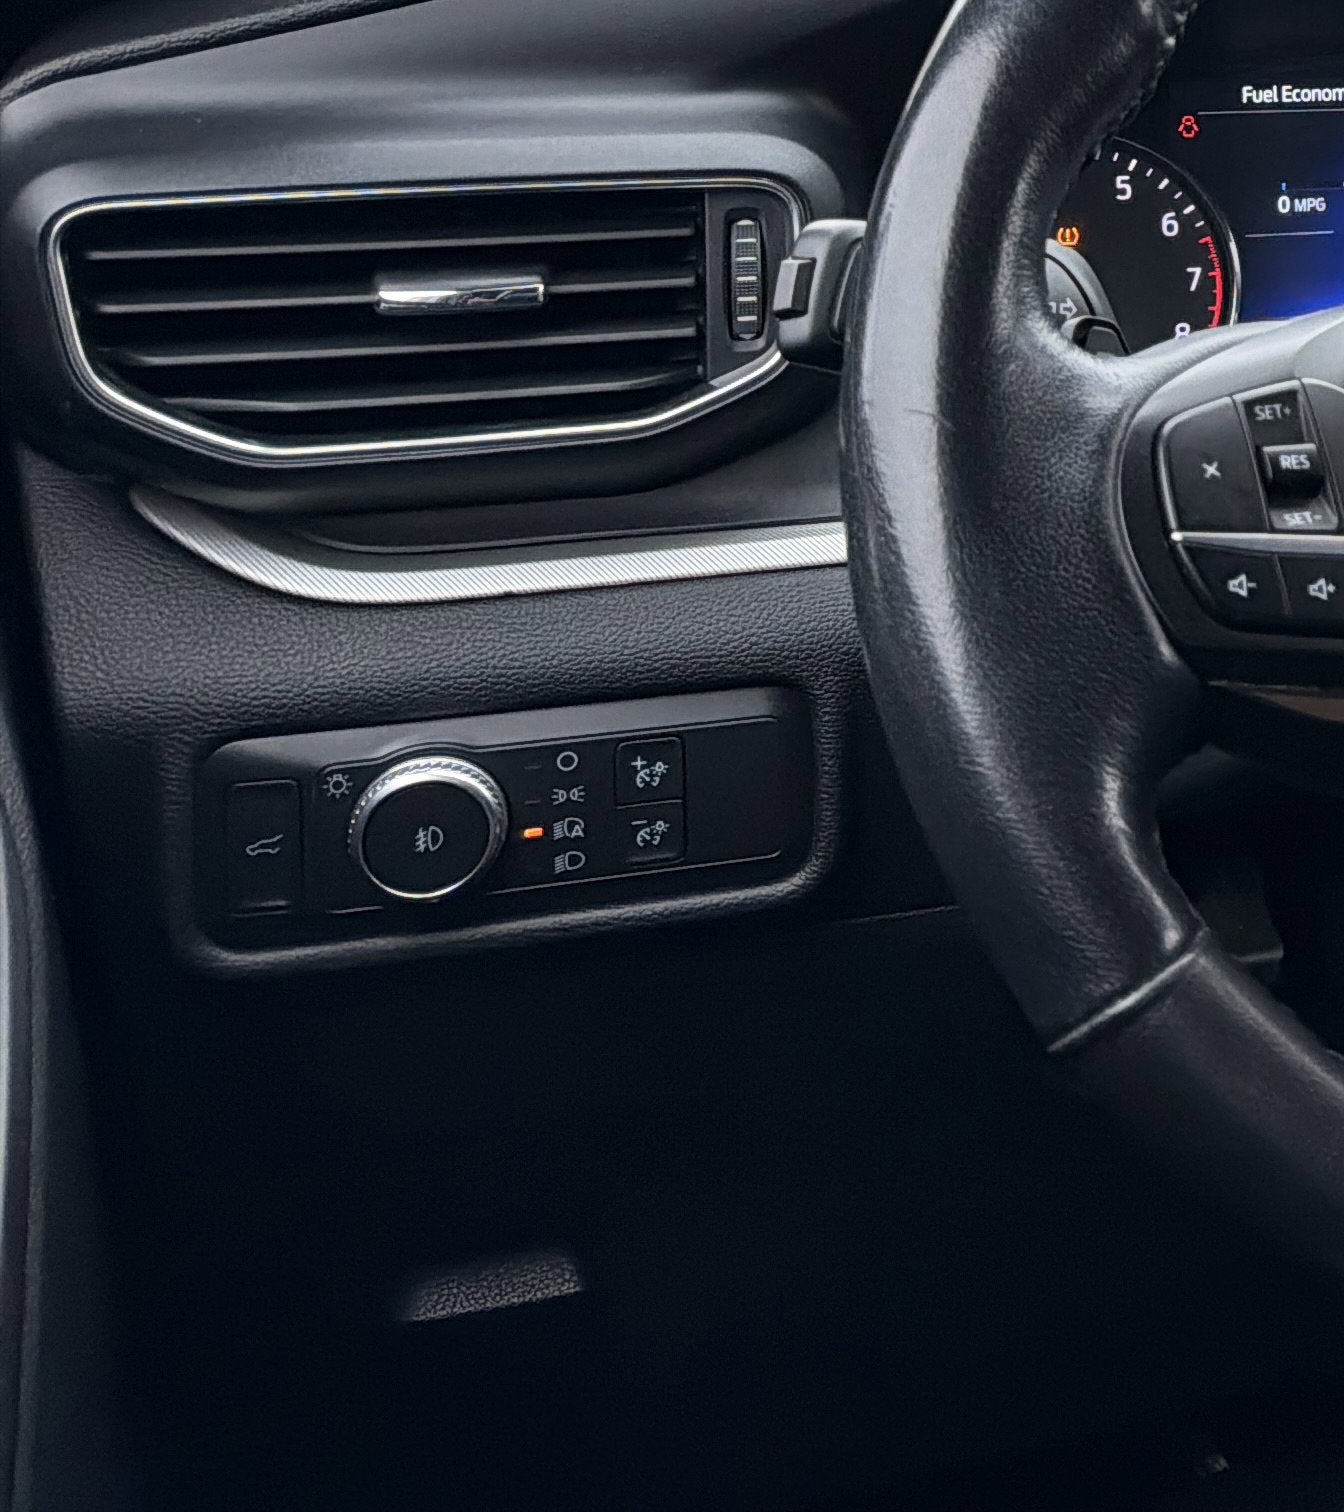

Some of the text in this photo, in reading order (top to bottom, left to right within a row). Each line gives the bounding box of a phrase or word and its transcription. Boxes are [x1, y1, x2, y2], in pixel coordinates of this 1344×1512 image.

[1242, 86, 1279, 104] Fuel
[1115, 175, 1132, 201] 5
[1277, 195, 1326, 214] 0 MPG
[1161, 211, 1179, 237] 6
[1186, 267, 1202, 292] 7
[1279, 454, 1311, 470] RES
